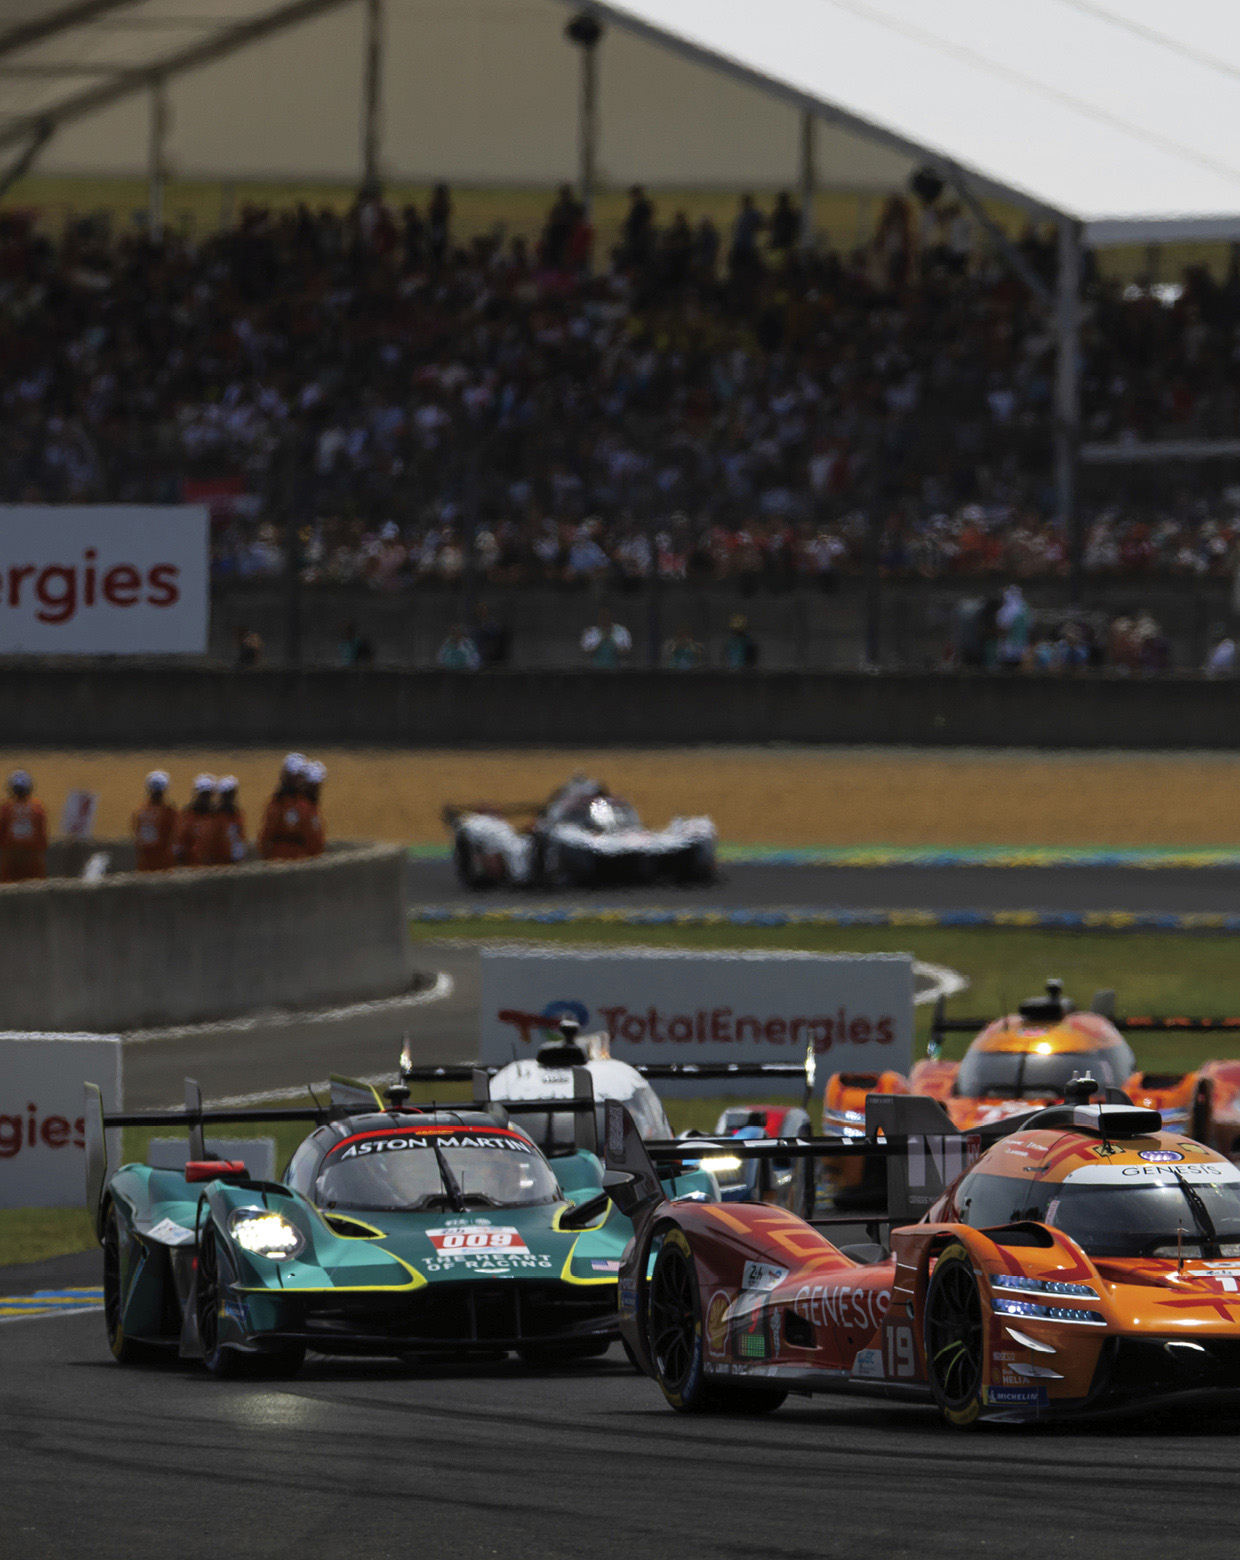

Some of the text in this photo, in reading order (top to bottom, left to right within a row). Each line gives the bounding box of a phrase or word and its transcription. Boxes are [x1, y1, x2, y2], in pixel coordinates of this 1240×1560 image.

[0, 546, 182, 625] rgies
[600, 1004, 894, 1055] TotalEnergies
[340, 1137, 532, 1160] ASTON MARTIN
[1121, 1164, 1223, 1177] GENESIS
[442, 1234, 513, 1248] 009
[421, 1253, 551, 1265] THE HEART
[427, 1260, 553, 1271] OF RACING
[794, 1285, 892, 1330] GENESIS
[886, 1325, 915, 1377] 19
[996, 1392, 1039, 1400] MICHELIN
